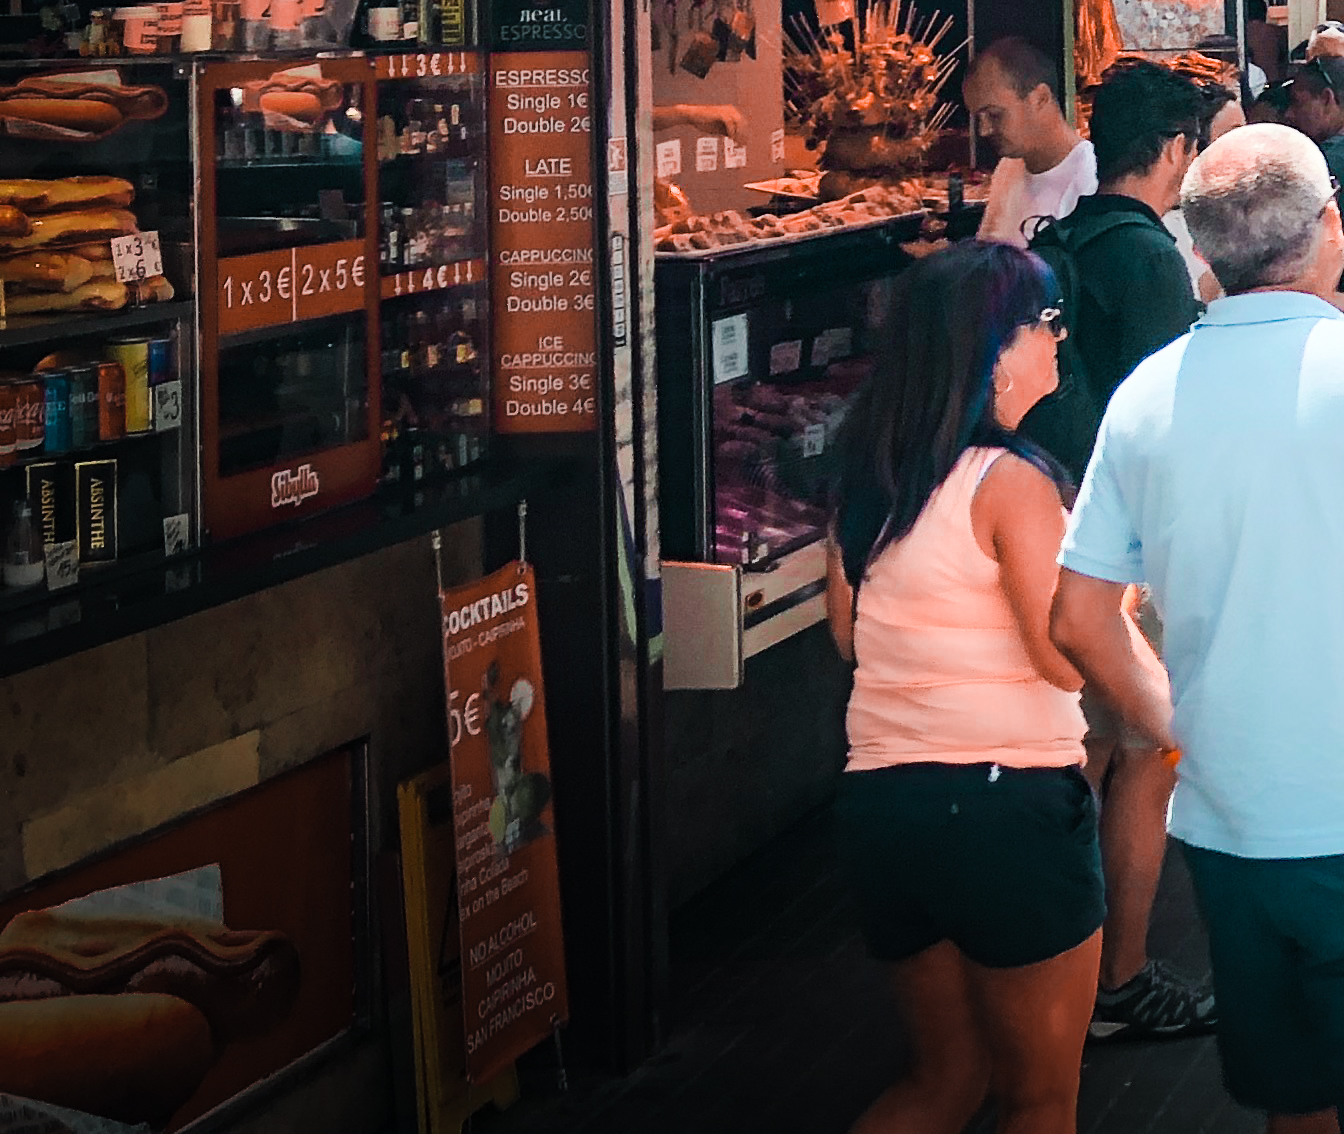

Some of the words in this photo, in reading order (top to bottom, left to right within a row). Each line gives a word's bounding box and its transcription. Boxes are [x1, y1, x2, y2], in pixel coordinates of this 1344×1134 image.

[500, 24, 587, 41] ESPRESSO
[507, 93, 561, 113] Single
[567, 92, 589, 109] 1€
[503, 116, 566, 134] Double
[570, 116, 591, 133] 2€
[525, 158, 572, 175] LATE
[499, 185, 549, 203] Single
[498, 208, 552, 223] Double
[510, 271, 564, 291] Single
[568, 269, 591, 287] 2€
[506, 295, 568, 312] Double
[573, 294, 595, 311] 3€
[538, 336, 564, 350] ICE
[509, 374, 564, 396] Single
[568, 373, 591, 390] 3€
[505, 399, 568, 416] Double
[571, 397, 595, 415] 4€
[40, 478, 56, 543] ABSINTH
[90, 477, 105, 550] ABSINTHE
[472, 896, 485, 913] on
[485, 887, 500, 905] the
[469, 940, 487, 966] NO
[487, 910, 537, 954] ALCOHOL
[486, 948, 523, 987] MOJITO
[478, 966, 537, 1019] CAIPIRINHA
[467, 1026, 488, 1055] SAN
[488, 982, 555, 1037] FRANCISCO
